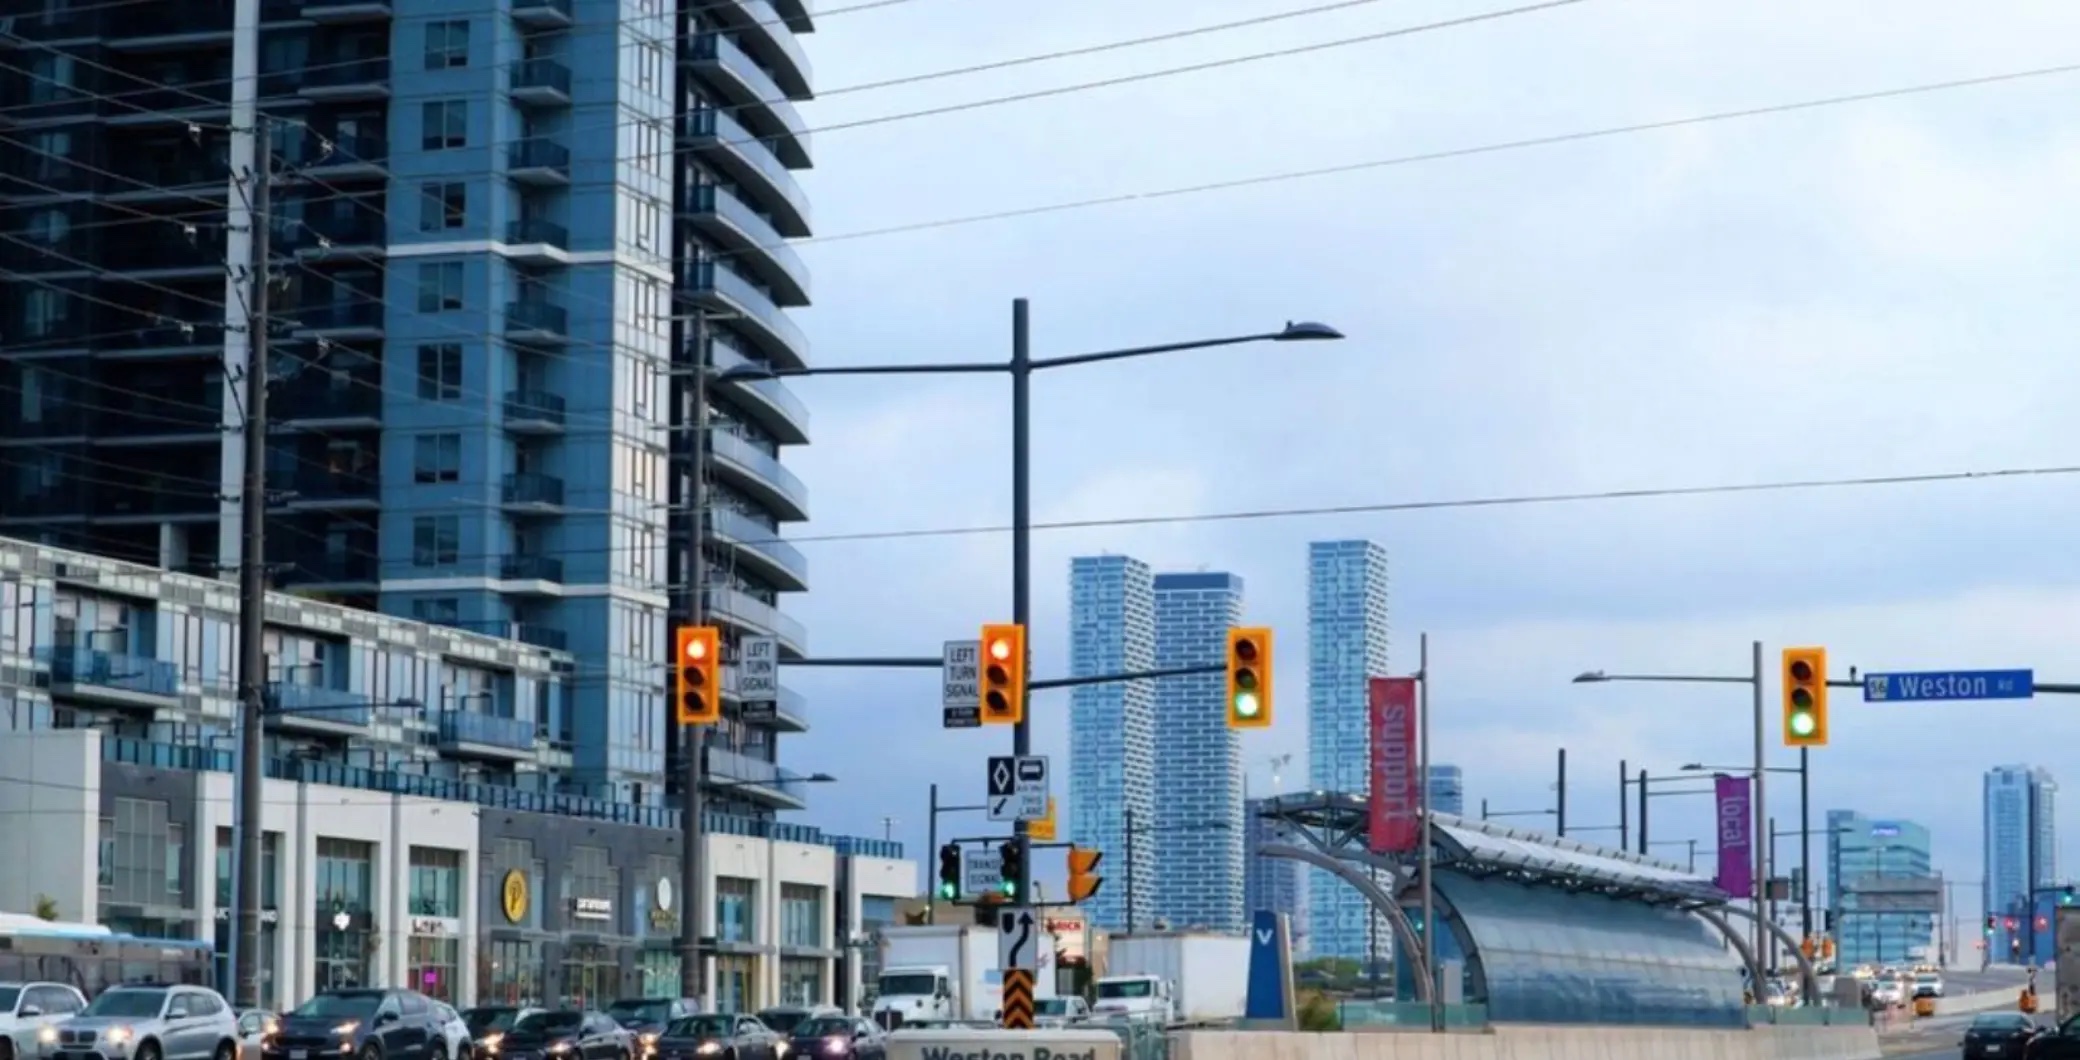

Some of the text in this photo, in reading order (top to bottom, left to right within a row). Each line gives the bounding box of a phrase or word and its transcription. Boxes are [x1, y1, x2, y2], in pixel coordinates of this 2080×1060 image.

[746, 642, 771, 657] LEFT
[950, 648, 974, 662] LEFT
[746, 660, 771, 675] TURN
[950, 666, 976, 680] TURN
[743, 677, 775, 690] SIGNAL
[945, 683, 980, 697] SIGNAL
[1899, 674, 1987, 698] Weston
[1374, 703, 1416, 822] support
[1721, 796, 1747, 848] local
[921, 1046, 1096, 1060] Weston Road
